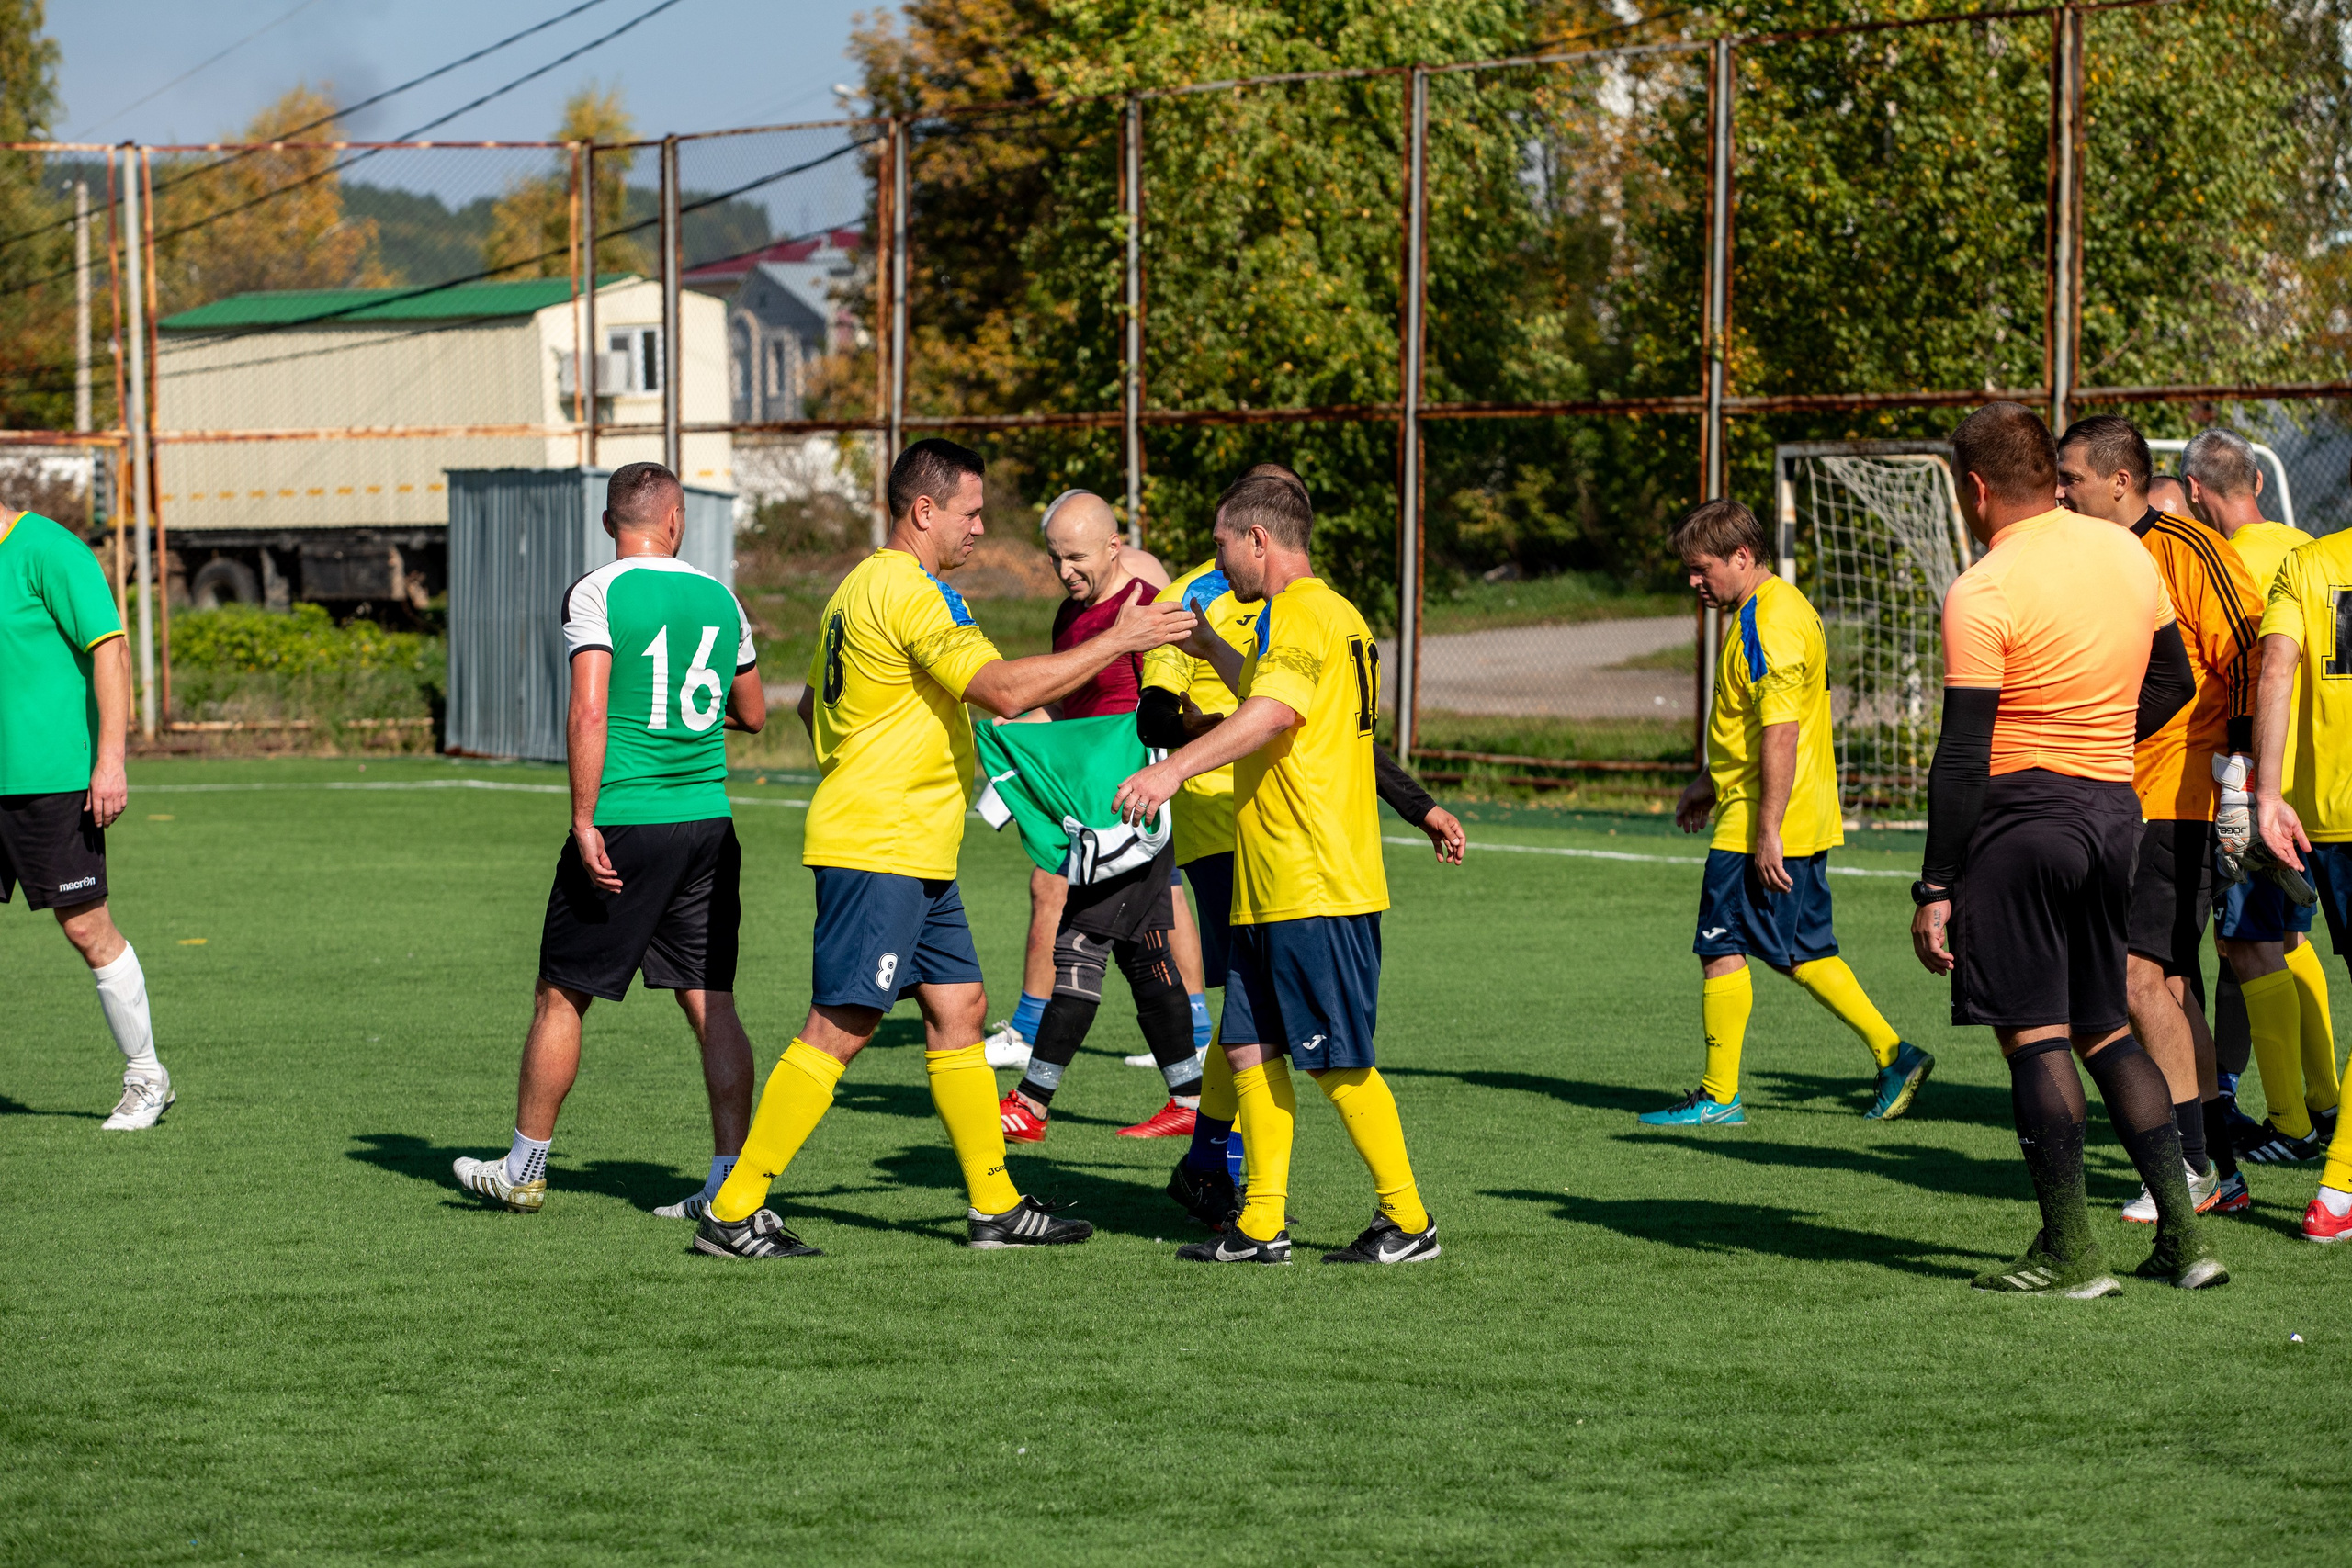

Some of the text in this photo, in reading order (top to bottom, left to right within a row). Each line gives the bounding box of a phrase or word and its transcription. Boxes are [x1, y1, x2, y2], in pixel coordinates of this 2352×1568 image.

[641, 624, 723, 732] 16
[821, 608, 847, 710] 8
[59, 876, 96, 892] macron
[876, 952, 899, 992] 8
